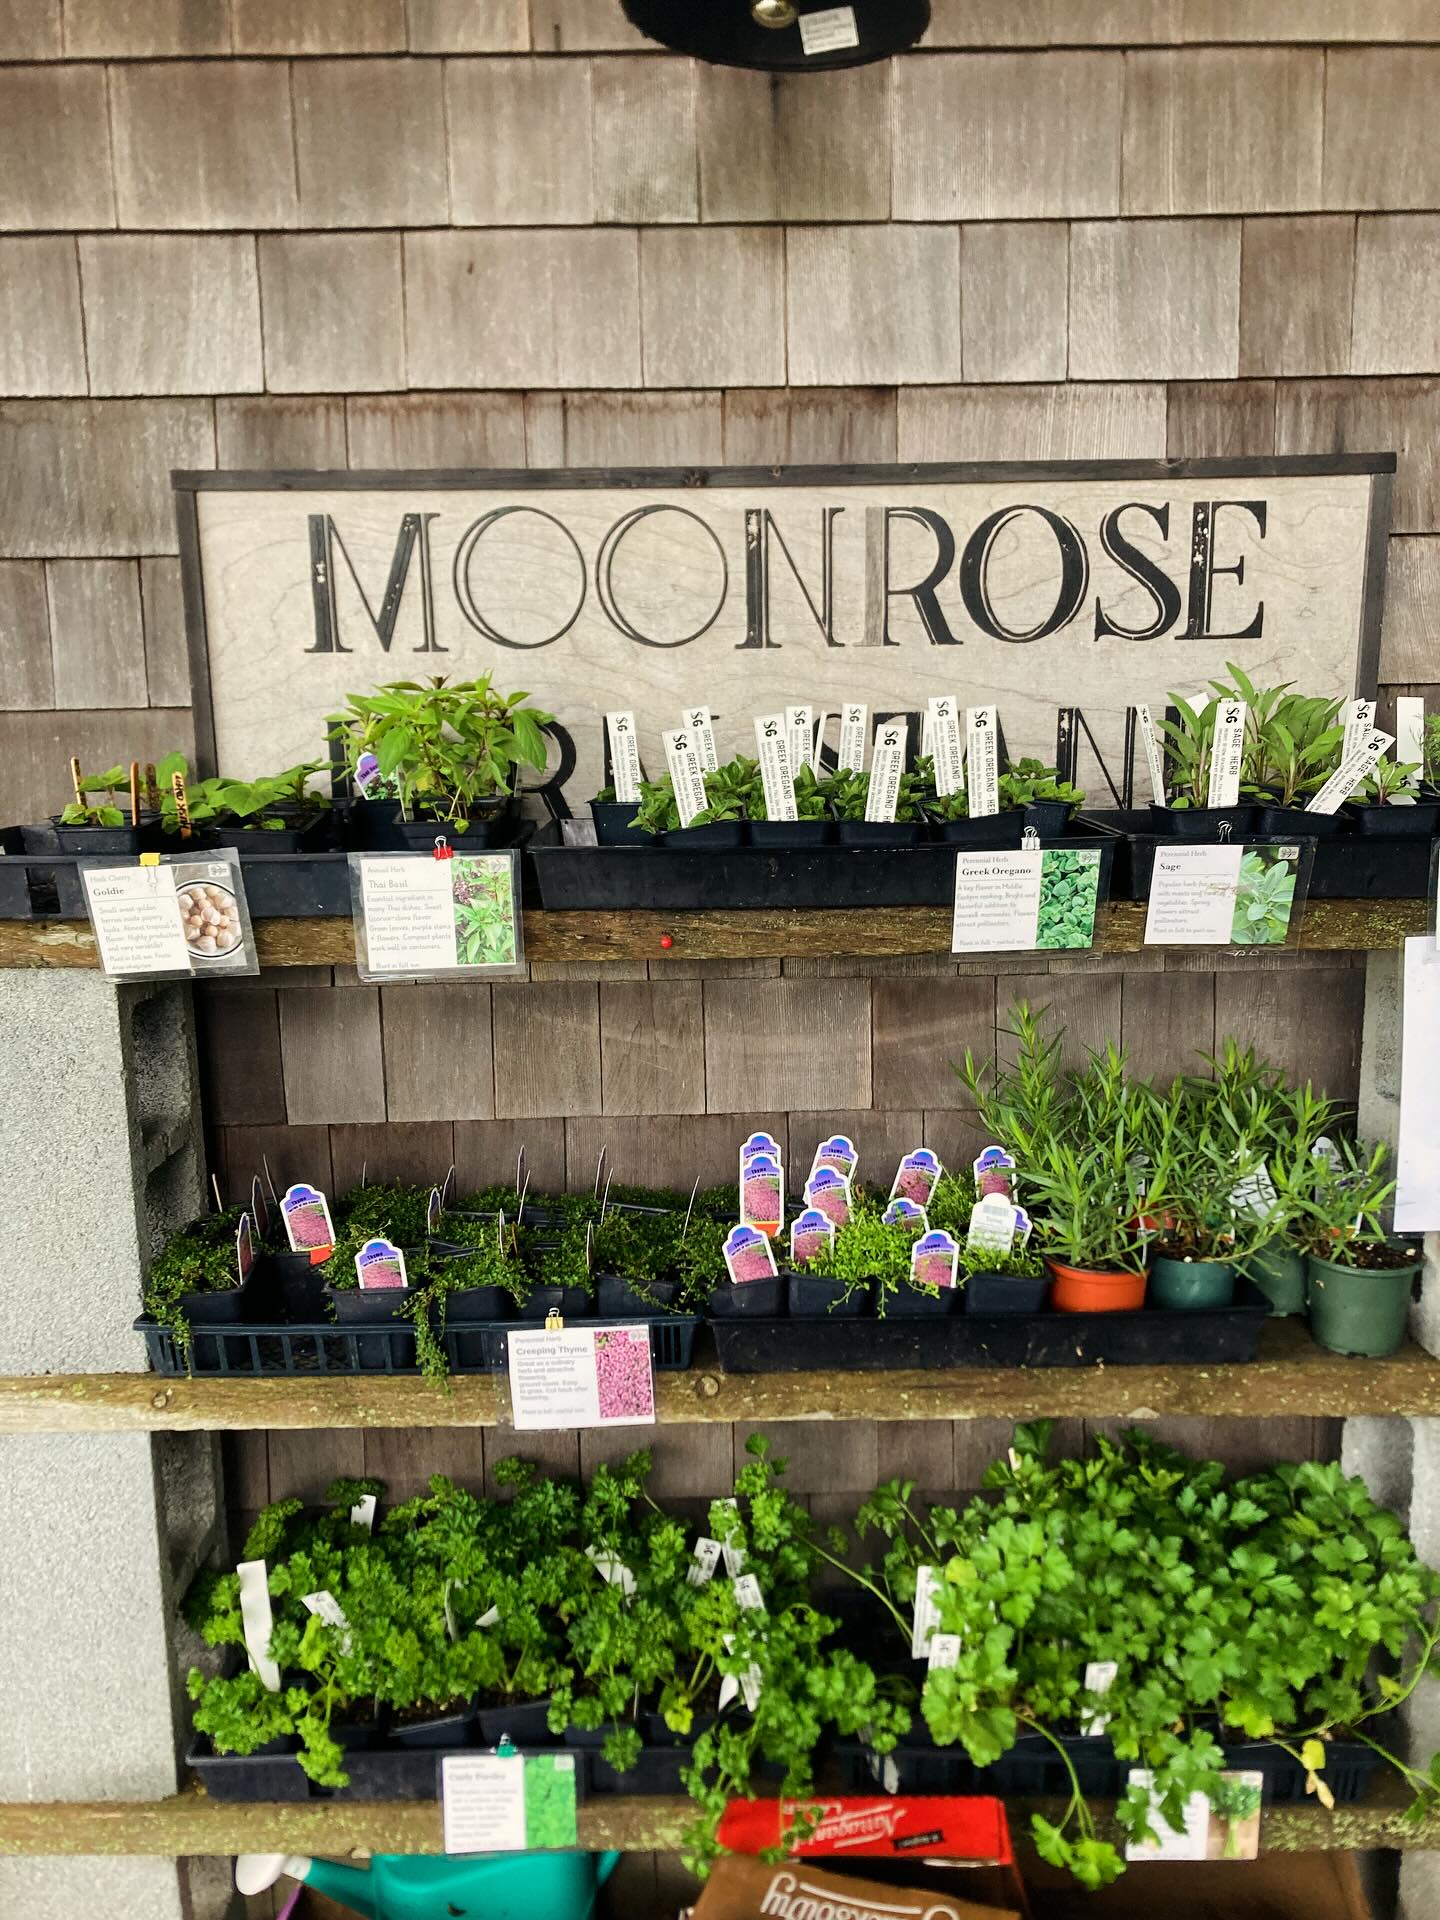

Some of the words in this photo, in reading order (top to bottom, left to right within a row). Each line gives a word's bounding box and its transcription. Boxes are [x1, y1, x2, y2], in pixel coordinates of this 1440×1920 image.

[305, 500, 1267, 653] MOONROSE
[849, 708, 861, 722] $6
[936, 700, 949, 717] $6
[1226, 707, 1240, 723] $6
[1357, 704, 1370, 719] $6
[616, 717, 628, 732] $6
[691, 711, 703, 727] $6
[794, 710, 806, 725] $6
[974, 711, 988, 728] $6
[763, 720, 778, 737] $6
[855, 726, 864, 748] GREEK
[947, 720, 957, 743] GREEK
[627, 735, 635, 757] GREEK
[673, 734, 688, 750] $6
[803, 729, 811, 751] GREEK
[884, 730, 899, 745] $6
[984, 731, 994, 755] GREEK
[1232, 728, 1242, 748] SAGE
[1368, 735, 1386, 751] $6
[702, 729, 712, 752] GREEK
[707, 753, 716, 772] OREG
[776, 740, 786, 764] GREEK
[889, 750, 901, 773] GREEK
[950, 746, 961, 779] OREGANO
[1229, 755, 1239, 775] HERB
[1357, 755, 1376, 774] SAGE
[686, 752, 698, 776] GREEK
[692, 778, 705, 810] OREGANO
[780, 766, 792, 799] OREGANO
[985, 758, 995, 792] OREGANO
[884, 776, 897, 809] OREGANO
[1340, 778, 1355, 795] HERB
[992, 867, 1031, 876] Oregano
[1160, 863, 1181, 872] Sage
[94, 887, 124, 896] Goldie
[368, 880, 386, 888] Thai
[389, 880, 408, 888] Basil
[412, 924, 431, 932] purple
[516, 1347, 556, 1355] Creeping
[559, 1346, 587, 1354] Thyme
